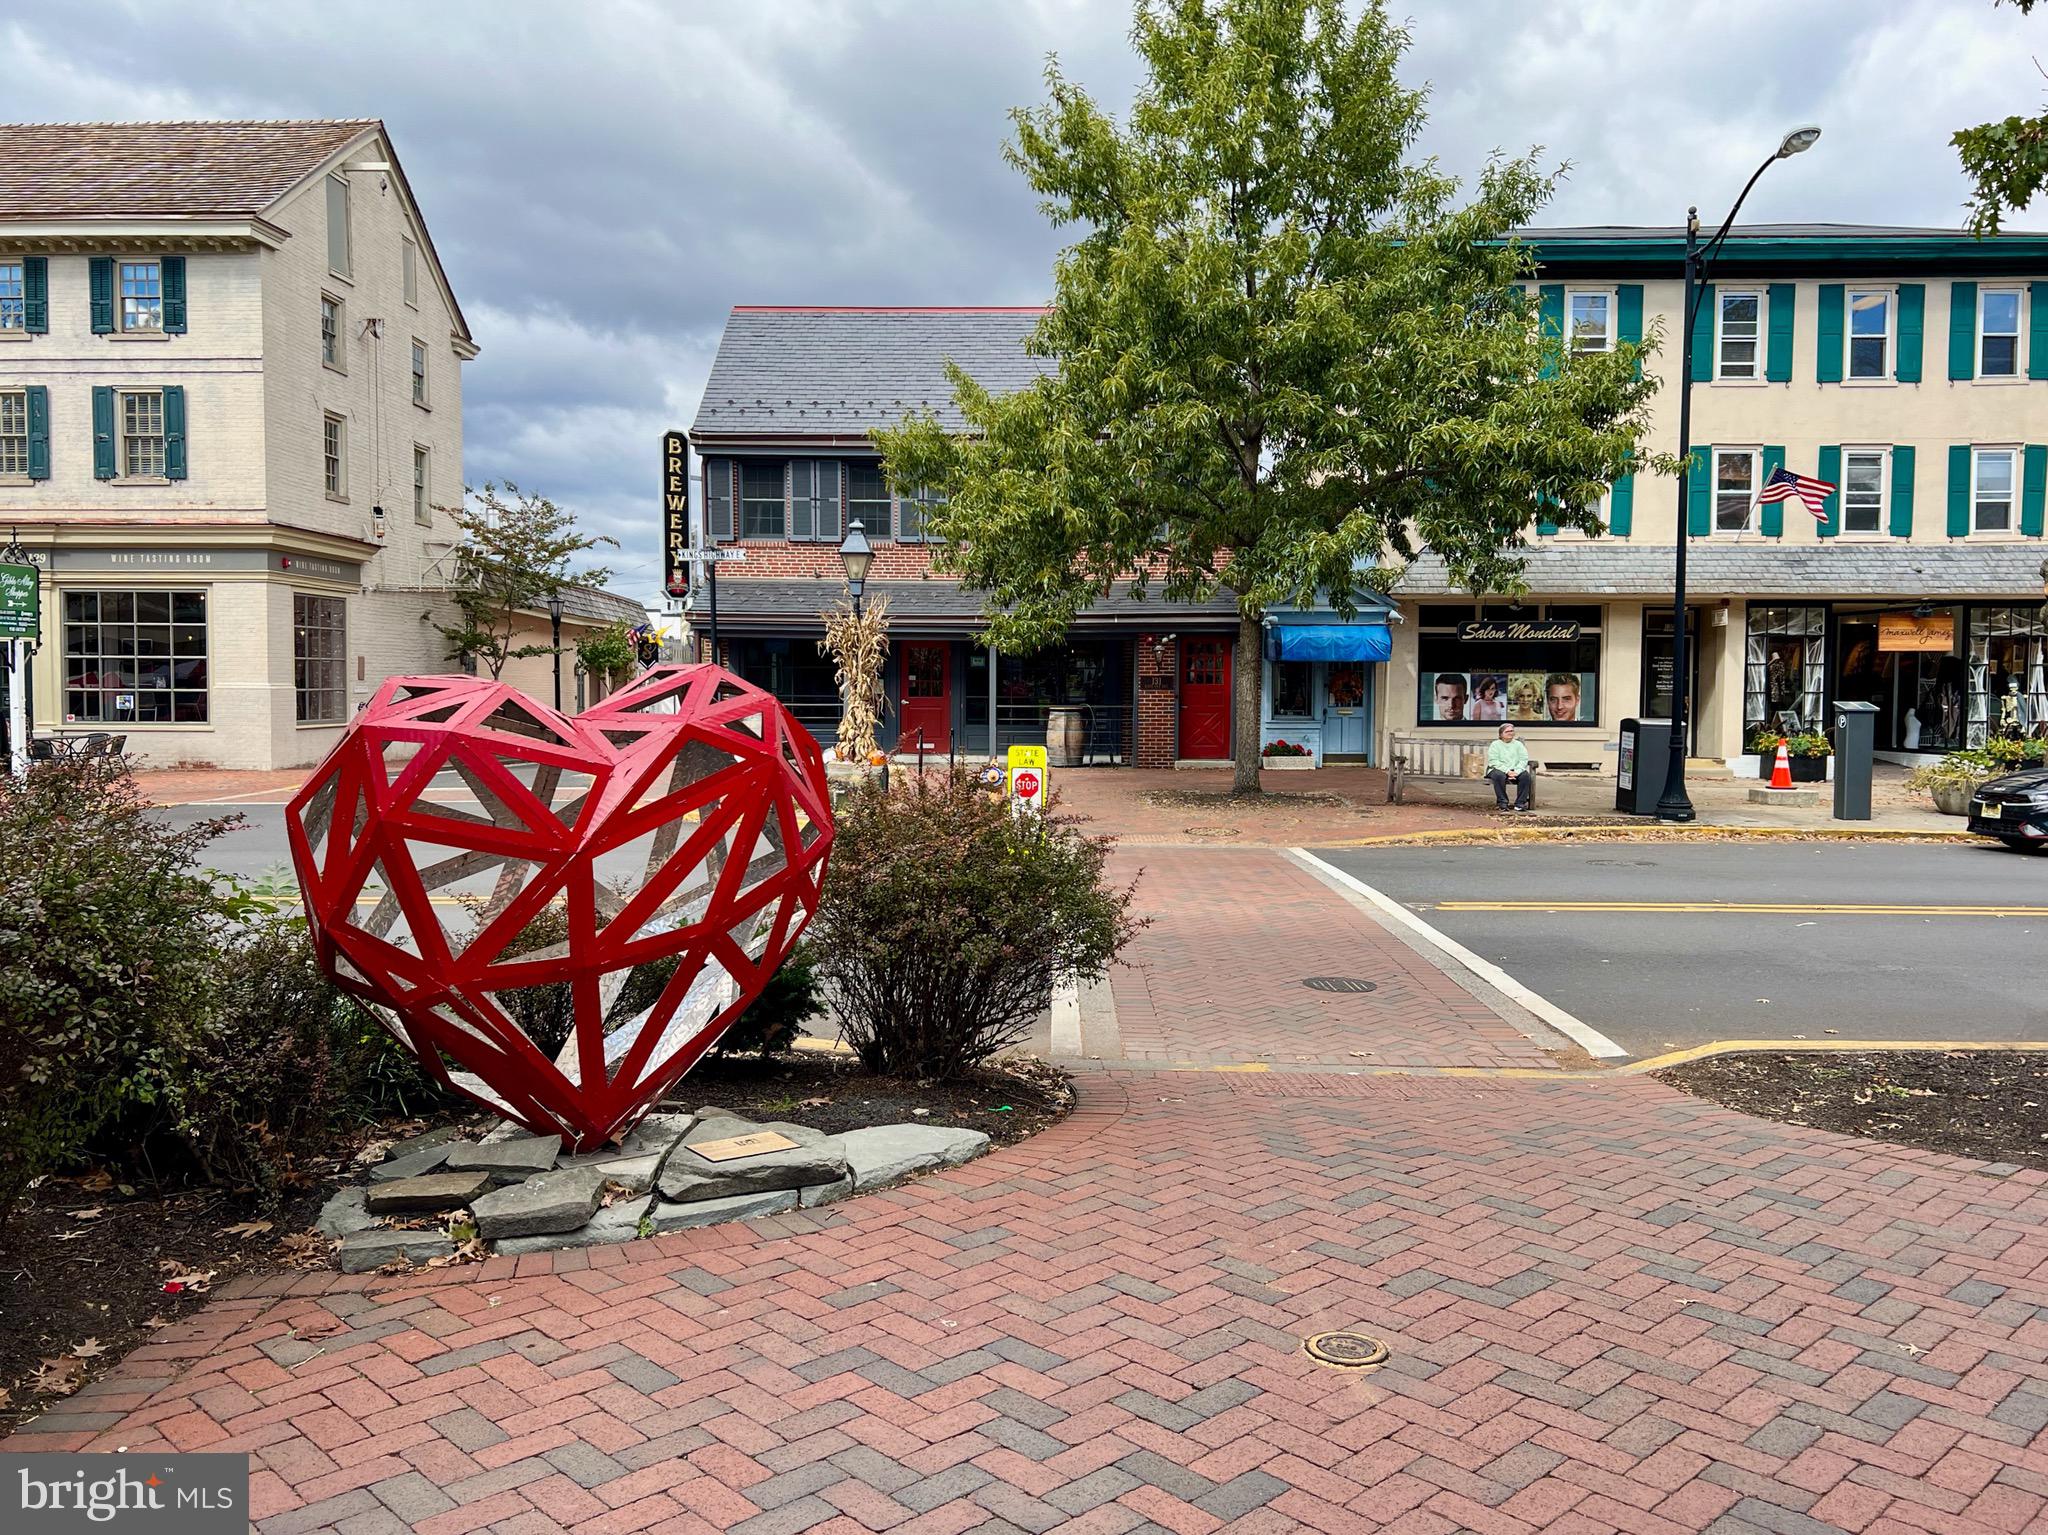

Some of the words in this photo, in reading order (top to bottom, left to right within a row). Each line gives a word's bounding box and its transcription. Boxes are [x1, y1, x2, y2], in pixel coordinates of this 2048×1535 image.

[666, 438, 686, 567] BREWERY
[111, 554, 134, 563] WINE
[140, 554, 180, 563] TASTING
[186, 554, 211, 563] ROOM
[682, 550, 703, 559] KINGS
[704, 550, 734, 559] HIGHWAY
[736, 551, 741, 559] E
[1461, 622, 1506, 640] Salon
[1507, 622, 1577, 640] Mondial
[1881, 625, 1923, 636] maxwell
[1015, 749, 1040, 757] STATE
[1019, 758, 1035, 766] LAW
[1015, 780, 1038, 791] STOP
